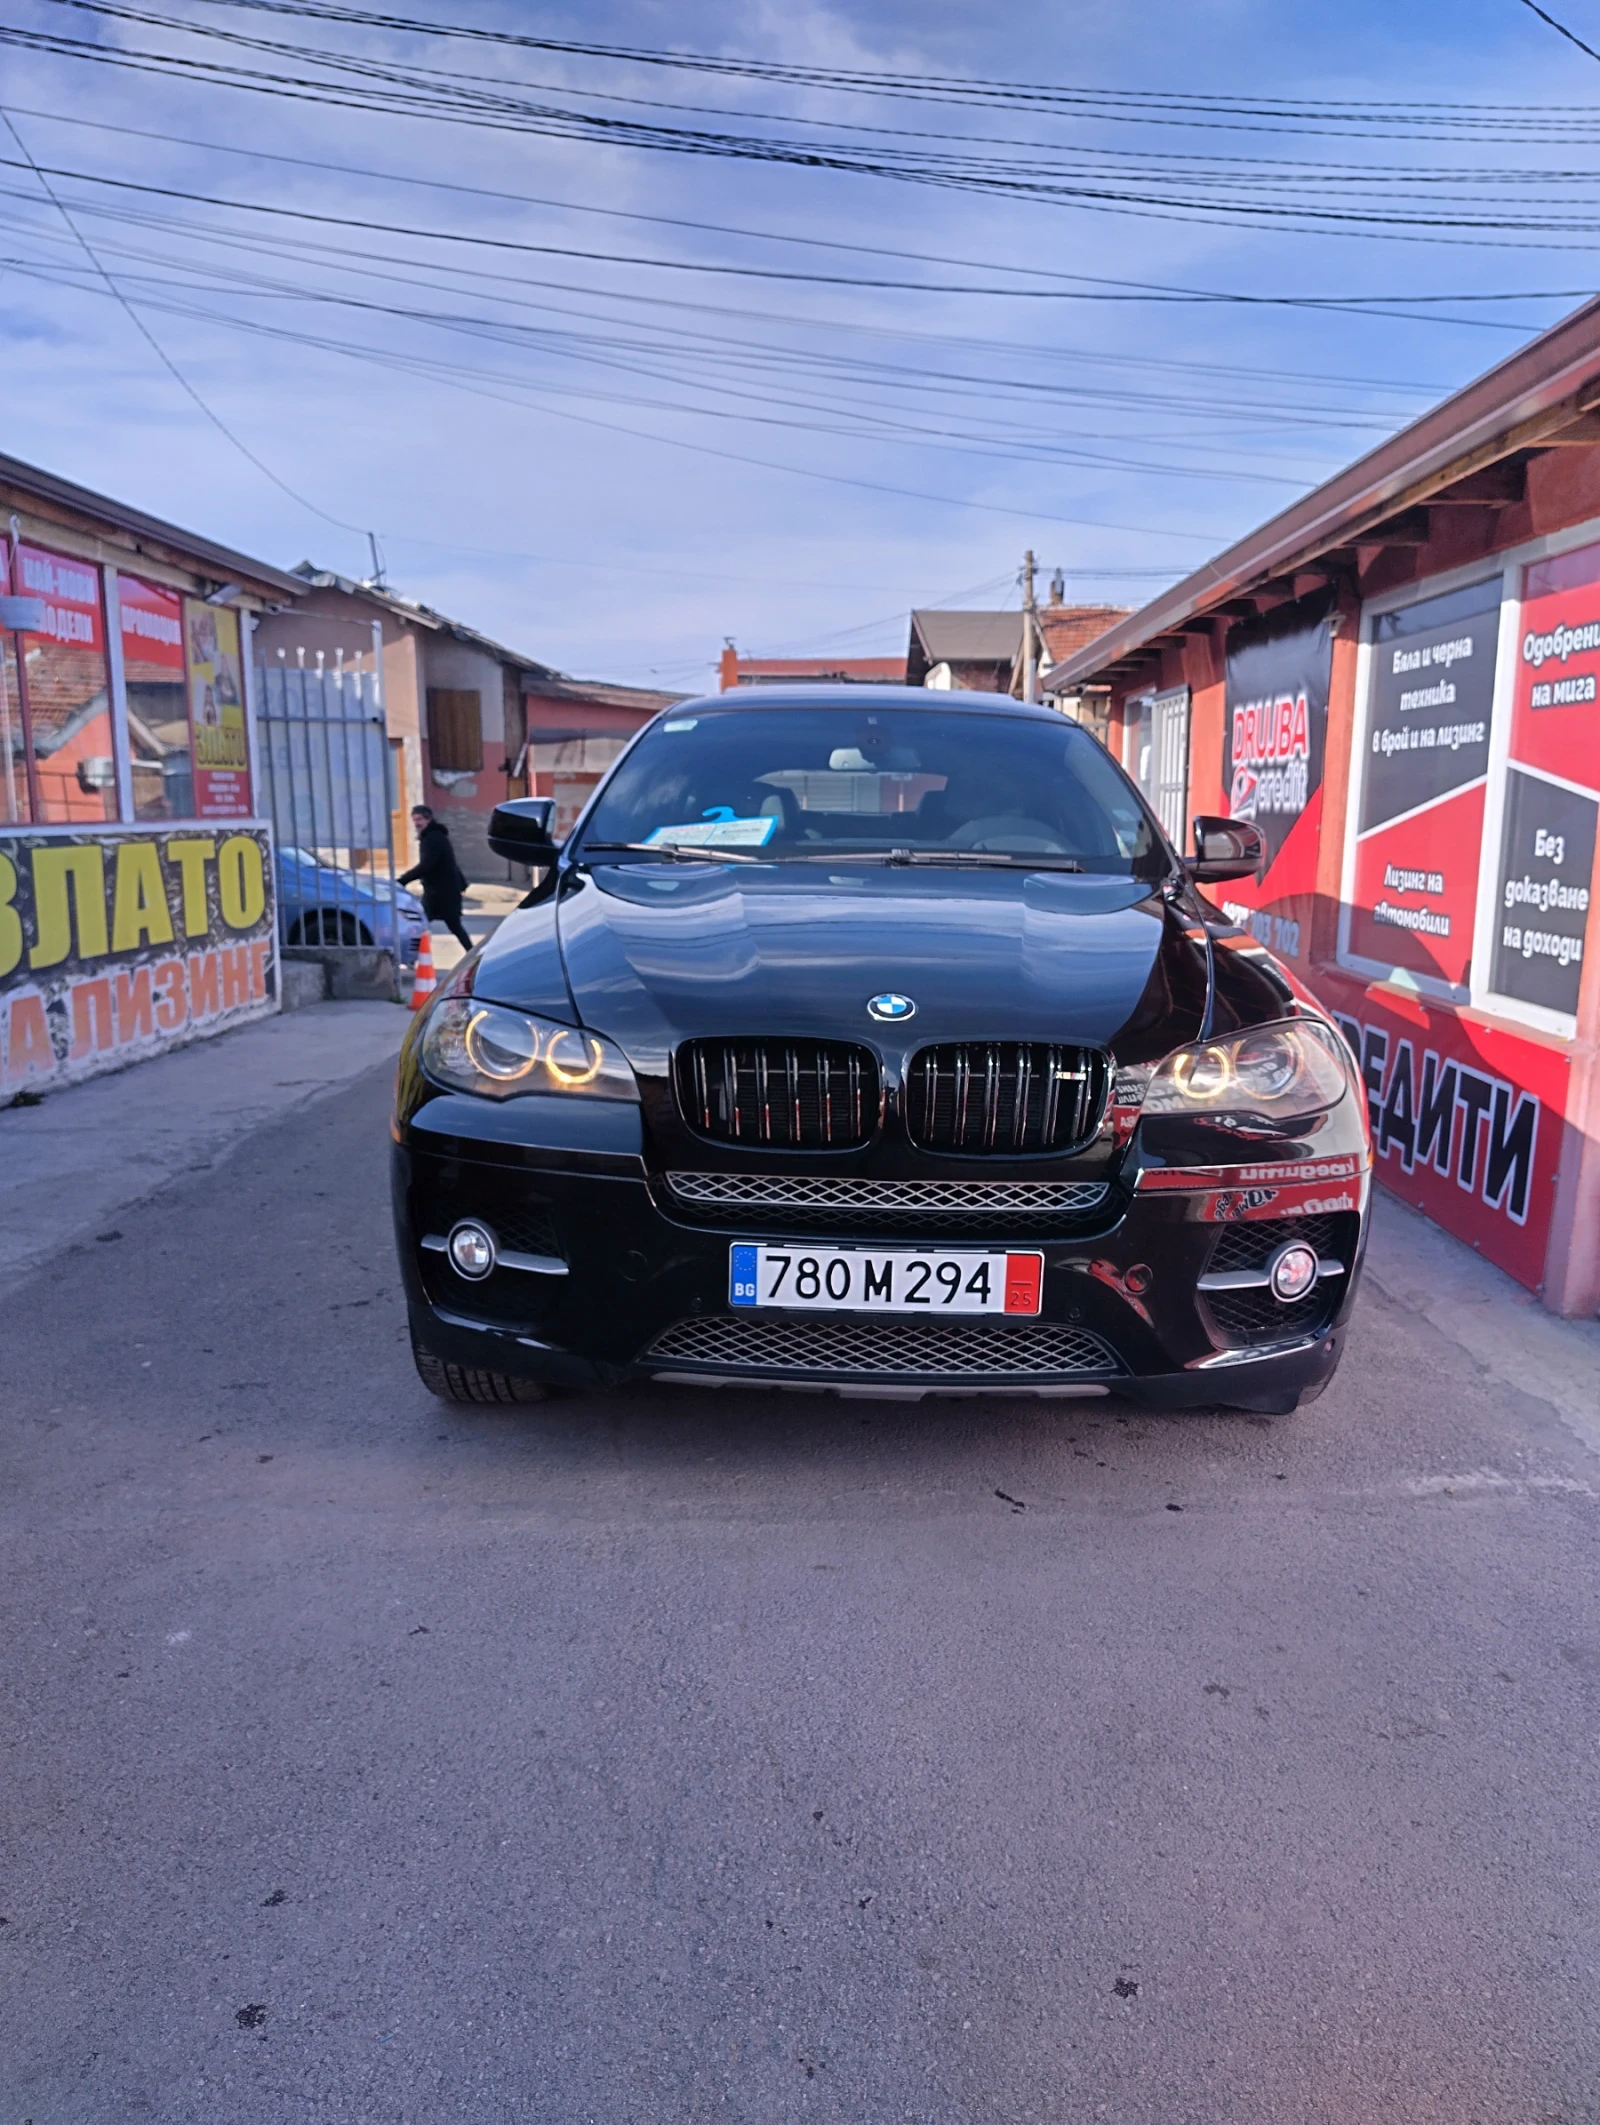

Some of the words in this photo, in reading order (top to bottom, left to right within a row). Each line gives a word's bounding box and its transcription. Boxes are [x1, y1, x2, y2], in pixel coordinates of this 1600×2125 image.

[1393, 649, 1421, 674] Бяла
[1422, 647, 1432, 667] и
[1432, 637, 1473, 668] черна
[1400, 679, 1456, 711] техника
[1532, 684, 1551, 707] на
[1553, 677, 1595, 704] мига
[1232, 692, 1310, 767] DRUJBA
[1381, 725, 1409, 757] брой
[1410, 729, 1419, 748] и
[1420, 728, 1436, 747] на
[1436, 721, 1485, 750] лизинг
[1258, 761, 1308, 814] credit
[1534, 829, 1565, 865] Без
[1384, 863, 1425, 893] Лизинг
[1427, 873, 1443, 893] на
[1504, 875, 1589, 912] доказване
[1373, 901, 1450, 936] автомобили
[1503, 925, 1522, 949] на
[1522, 929, 1583, 966] доходи
[71, 941, 270, 1060] ЛИЗИНГ
[734, 1283, 755, 1297] BG
[765, 1255, 851, 1300] 780
[864, 1259, 893, 1302] M
[904, 1260, 991, 1304] 294
[1010, 1291, 1031, 1306] 25
